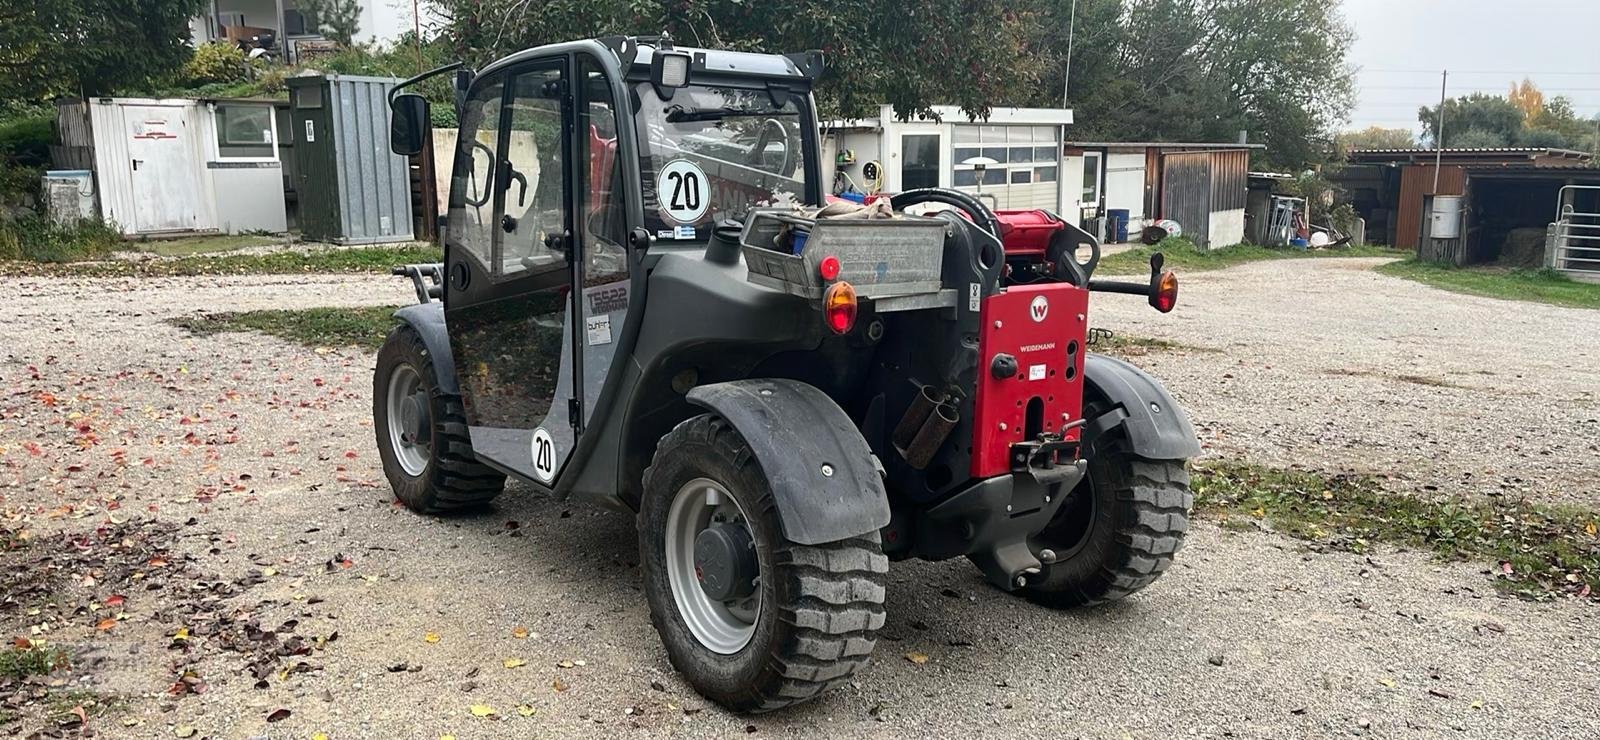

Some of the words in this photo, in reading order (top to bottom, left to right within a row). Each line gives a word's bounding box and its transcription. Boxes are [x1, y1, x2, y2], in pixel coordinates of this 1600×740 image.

[668, 171, 700, 211] 20
[1033, 305, 1047, 317] W
[1020, 342, 1056, 353] WEIDEMANN
[536, 436, 551, 472] 20
